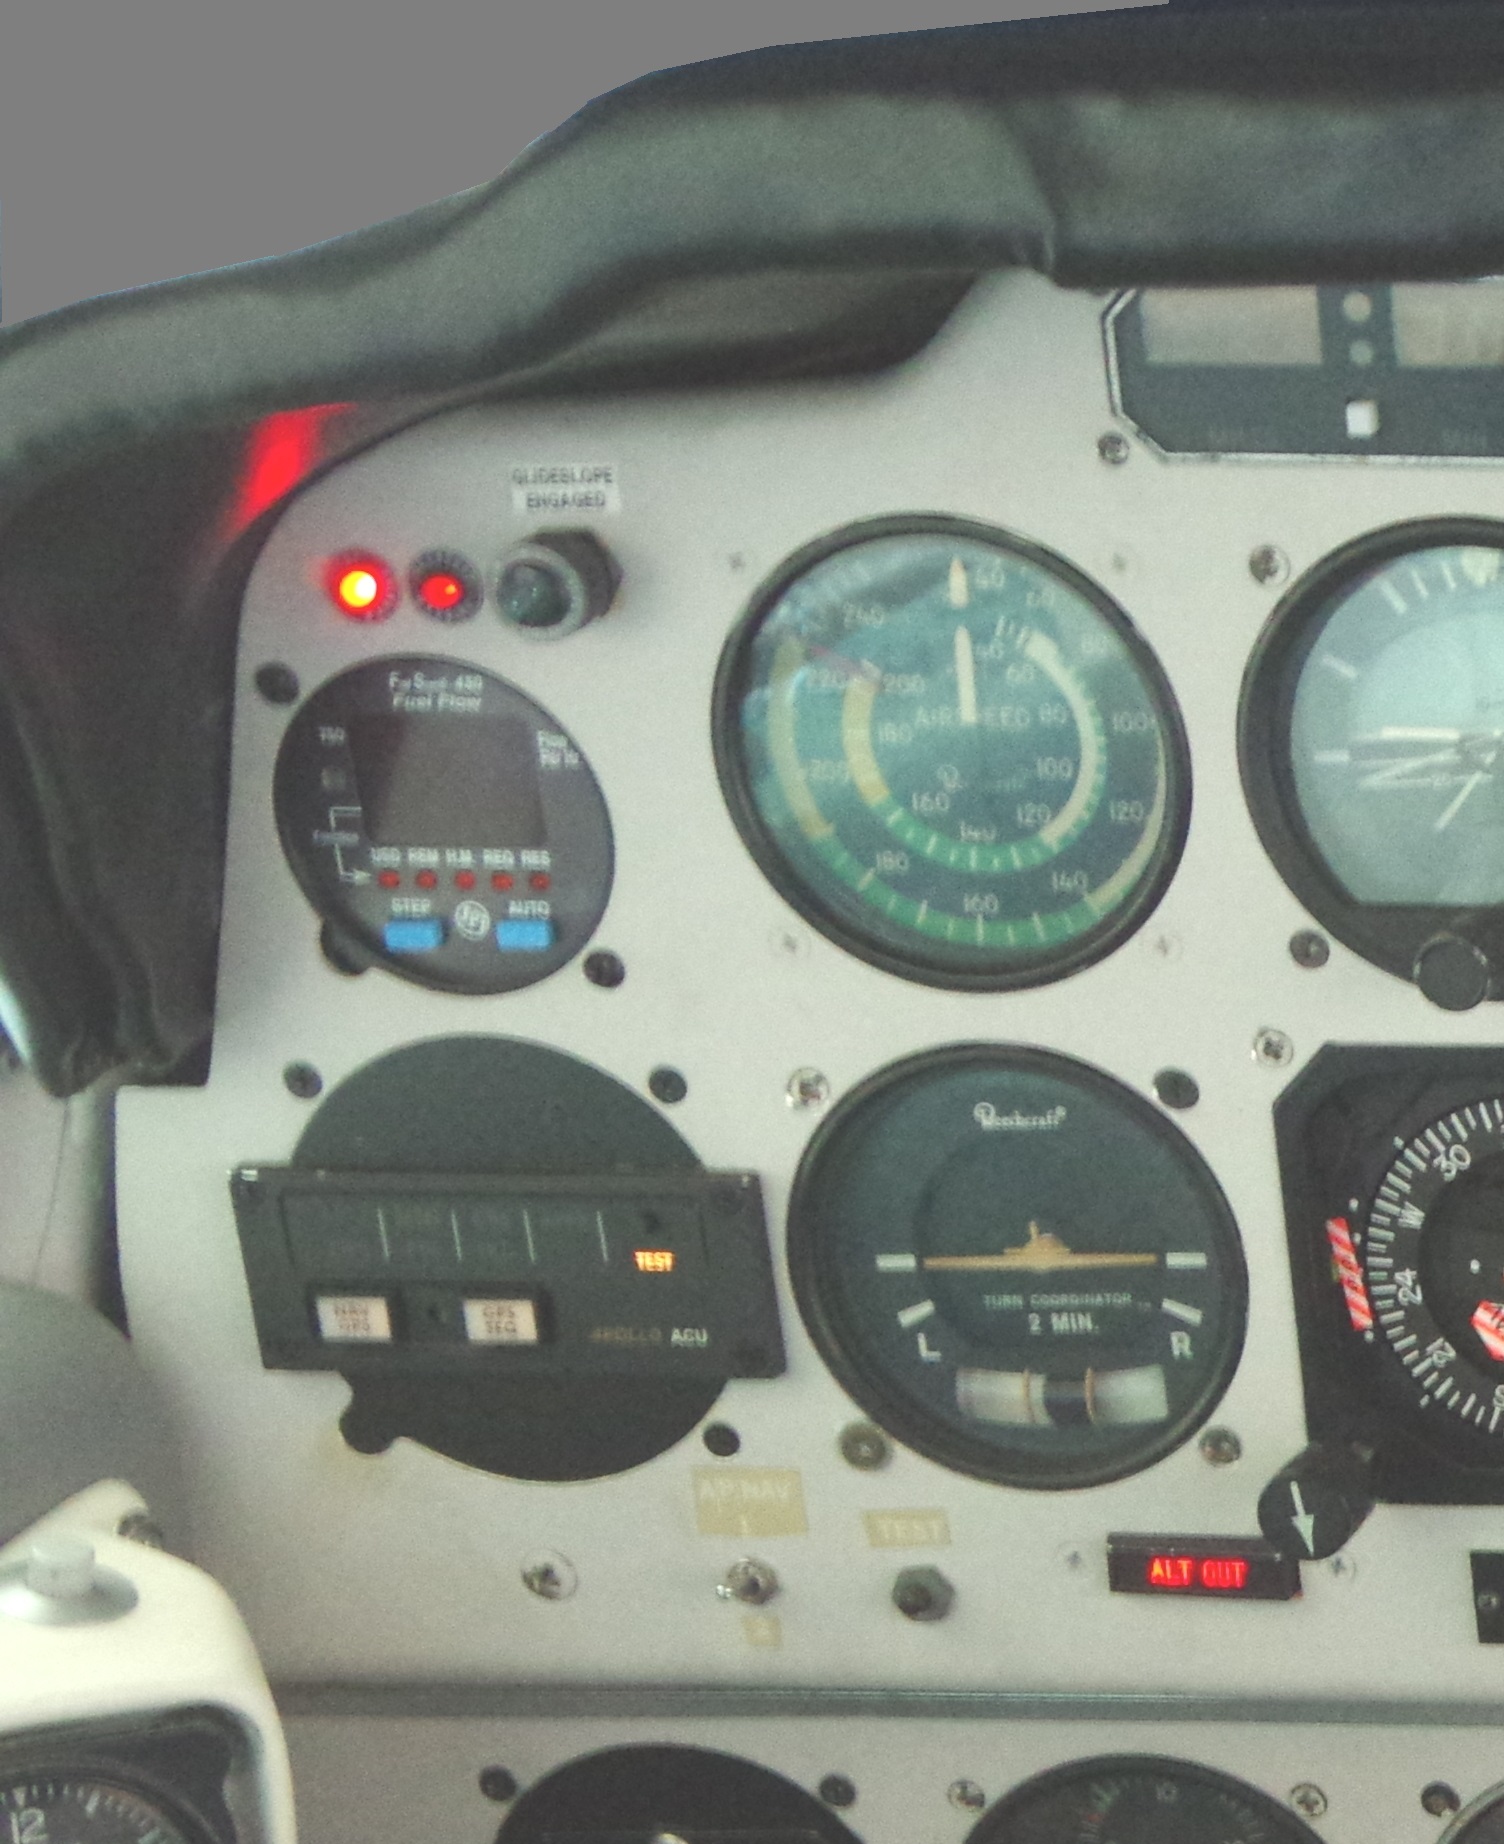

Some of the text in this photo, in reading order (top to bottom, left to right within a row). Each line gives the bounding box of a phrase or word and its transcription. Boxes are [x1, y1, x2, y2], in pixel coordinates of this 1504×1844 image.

[526, 492, 605, 509] ENGAGED
[984, 1292, 1132, 1309] TURN COORDINATOR
[1028, 1313, 1100, 1335] 2 MIN.
[1150, 1558, 1247, 1589] ALT OUT
